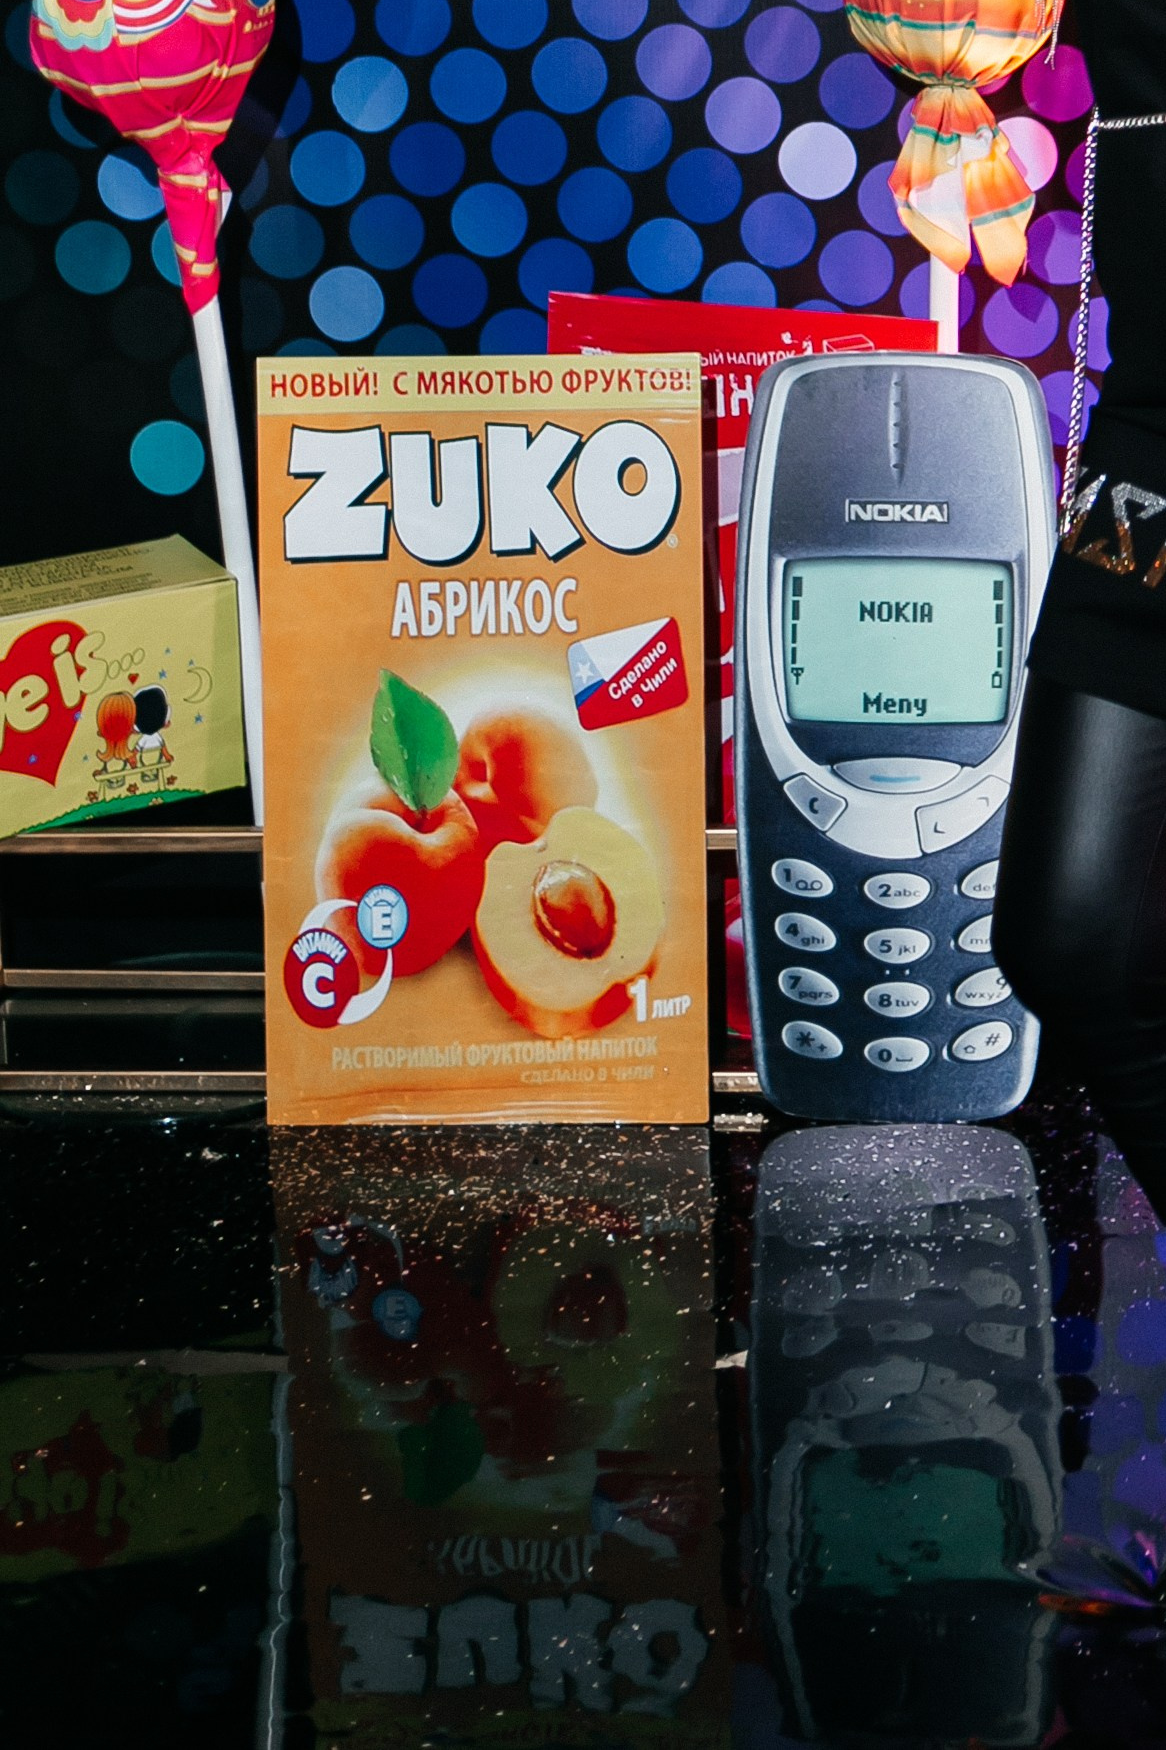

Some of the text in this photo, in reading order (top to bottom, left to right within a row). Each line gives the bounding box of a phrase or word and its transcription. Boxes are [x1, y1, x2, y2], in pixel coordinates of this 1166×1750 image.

[270, 366, 378, 398] НОВЫЙ!
[393, 371, 409, 397] С
[416, 368, 553, 396] МЯКОТЬЮ
[561, 367, 692, 395] ФРУКТОВ!
[284, 418, 682, 564] ZUKO
[850, 503, 944, 522] NOKIA
[390, 577, 580, 639] АБРИКОС
[858, 600, 934, 624] NOKIA
[608, 640, 668, 700] Сделано
[640, 657, 678, 693] Чили
[862, 691, 928, 717] Meny
[630, 978, 647, 1023] 1
[331, 1035, 658, 1071] РАСТВОРИМЫЙ ФРУКТОВЫЙ НАПИТОК
